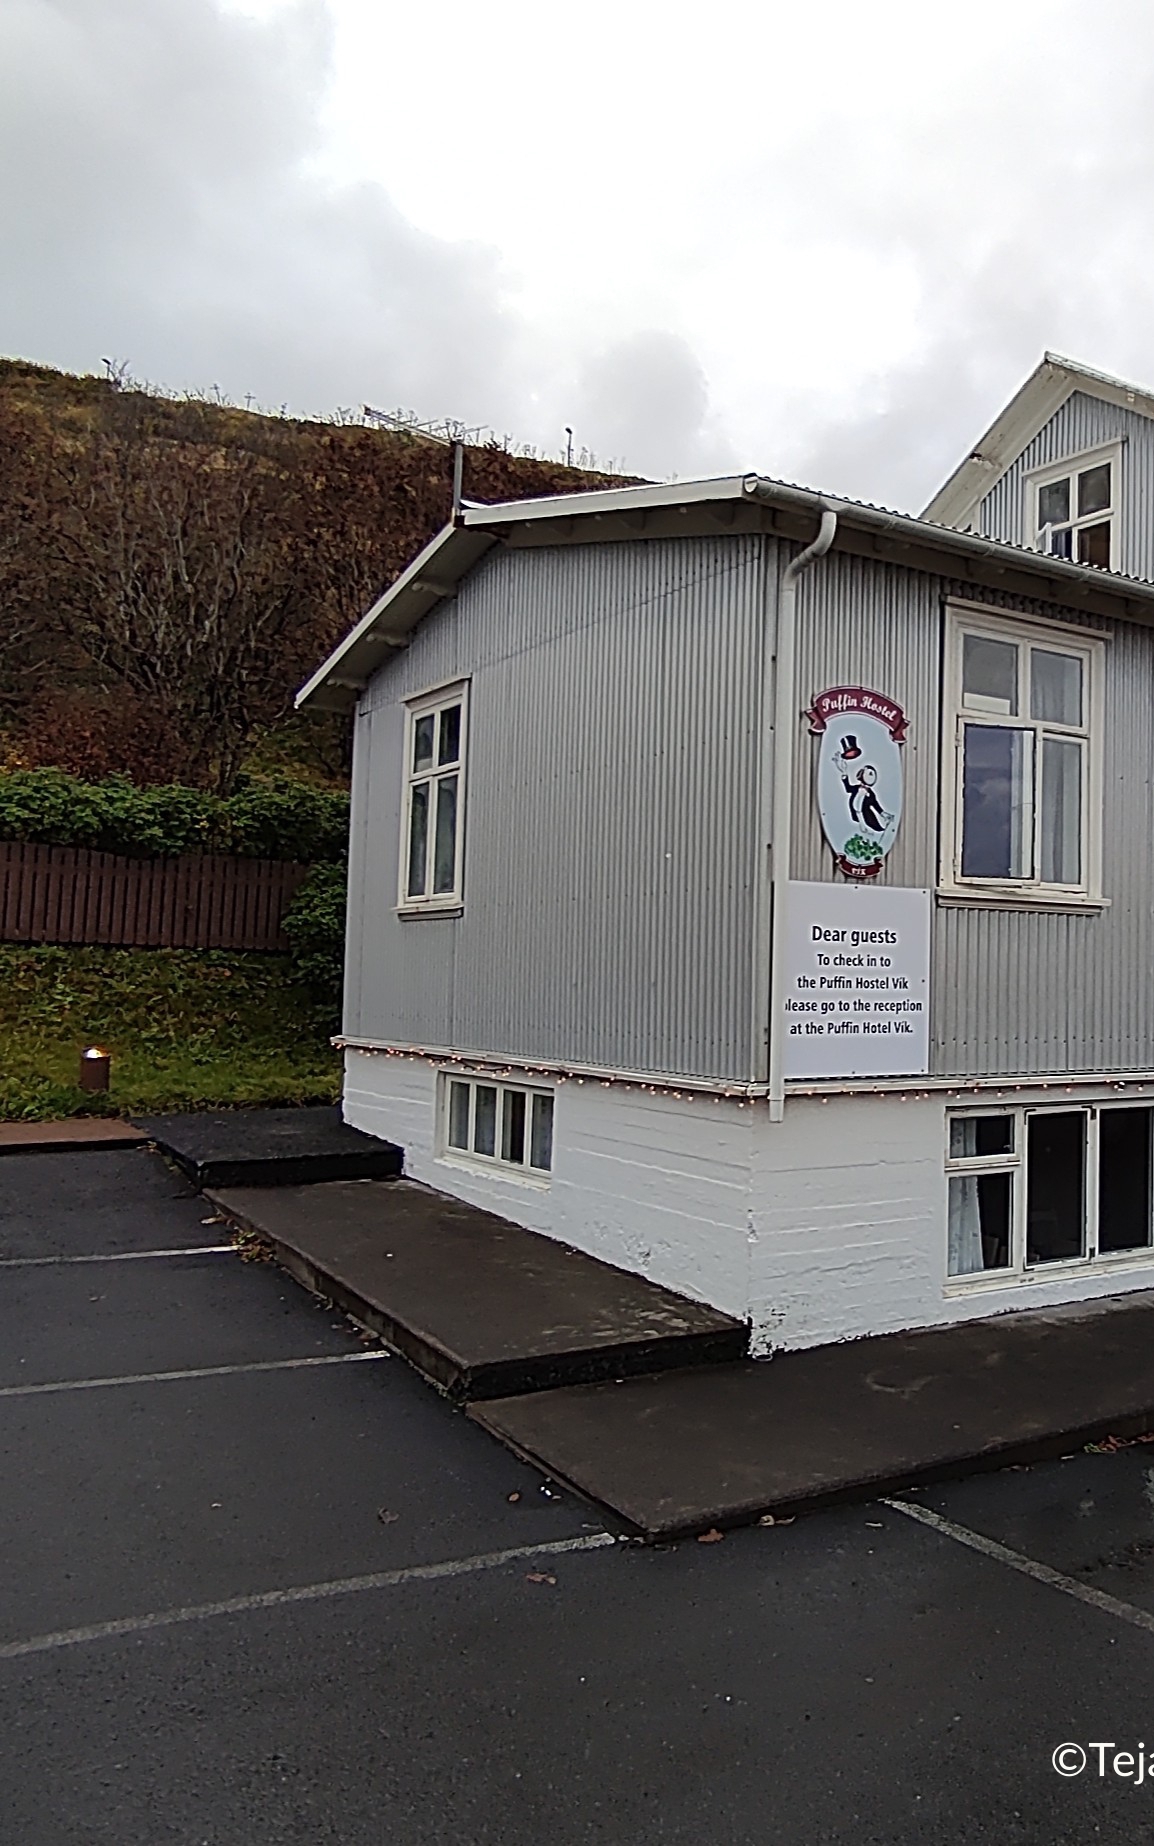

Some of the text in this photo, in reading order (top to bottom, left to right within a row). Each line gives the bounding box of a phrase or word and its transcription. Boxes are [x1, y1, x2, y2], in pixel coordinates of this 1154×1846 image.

[822, 694, 897, 720] Puffin Hostel
[812, 926, 897, 946] Dear guests
[817, 954, 891, 967] To check in to
[797, 976, 816, 989] the
[820, 976, 852, 989] Puffin
[856, 977, 889, 989] Hostel
[821, 1002, 835, 1014] go
[839, 1001, 850, 1011] to
[853, 999, 871, 1011] the
[874, 999, 922, 1014] reception
[790, 1024, 802, 1035] at
[806, 1023, 824, 1035] the
[828, 1022, 860, 1034] Puffin
[863, 1021, 891, 1033] Hotel
